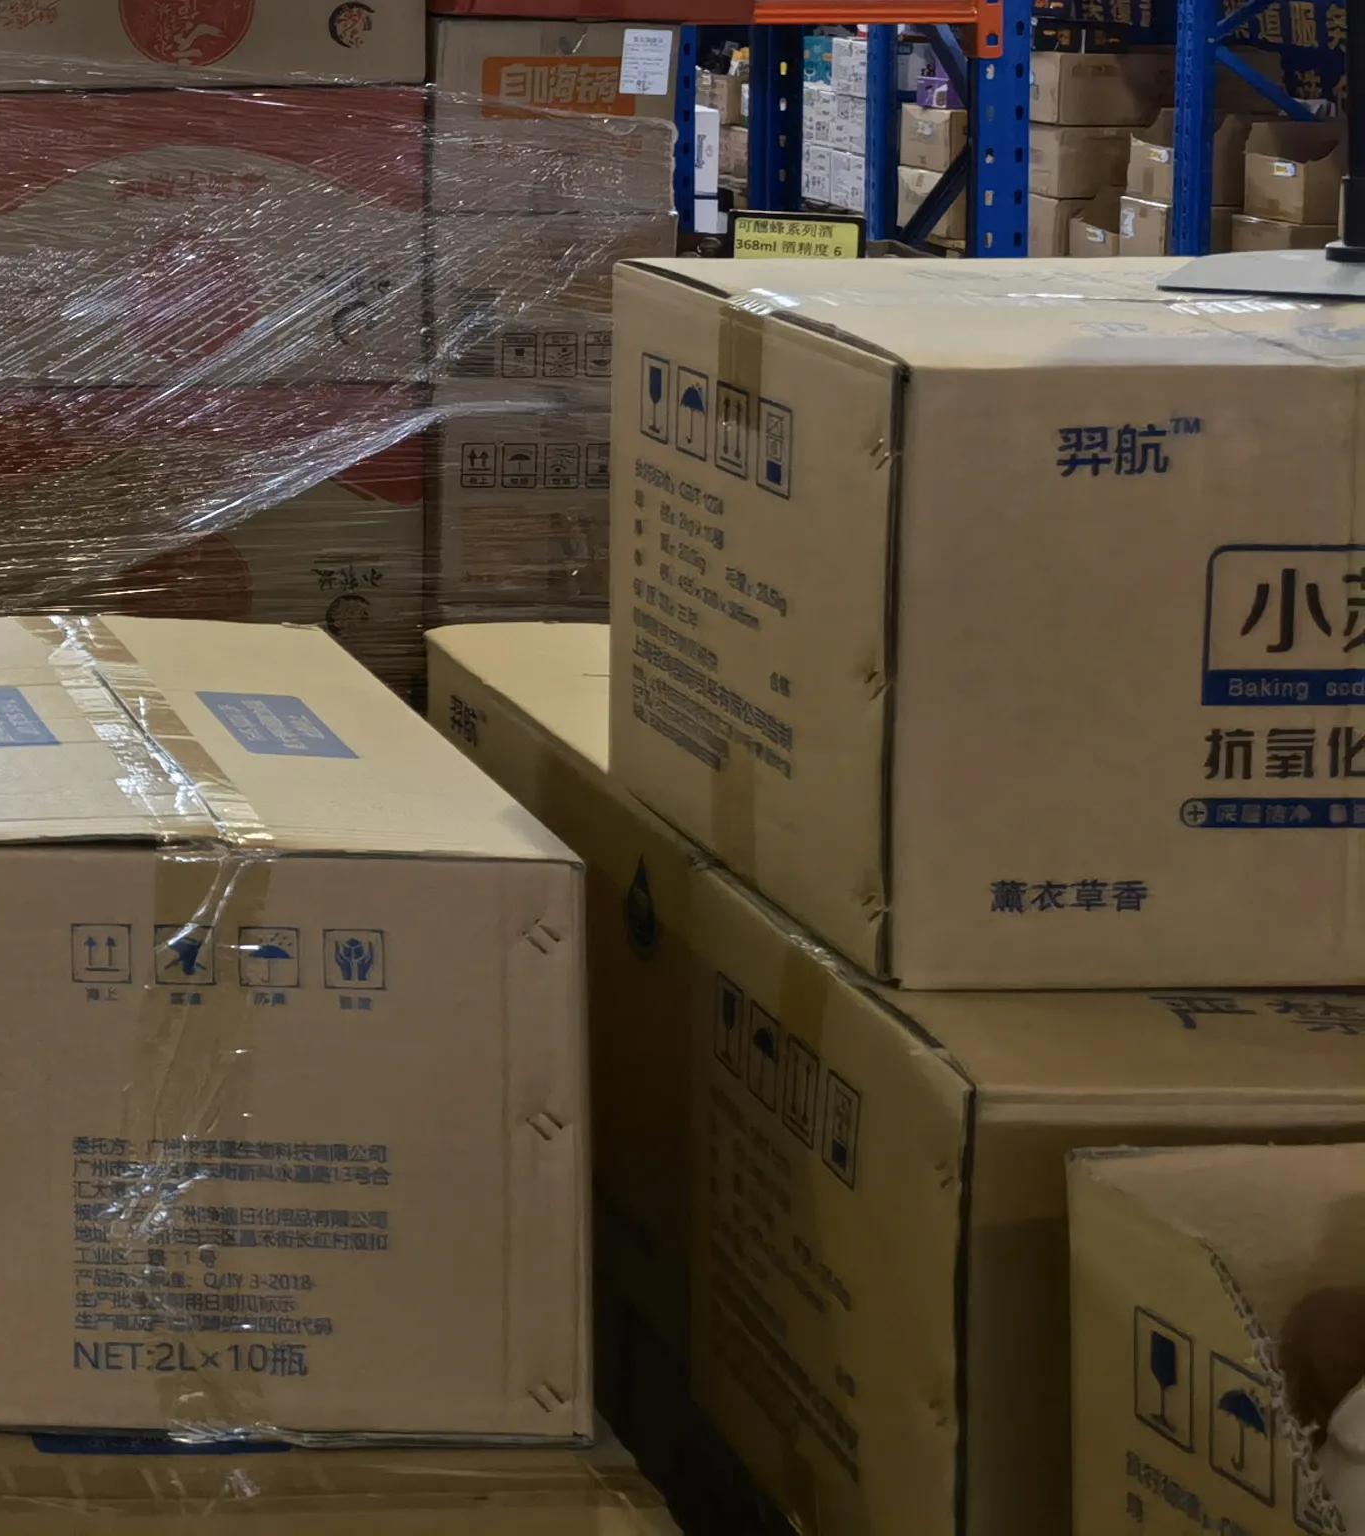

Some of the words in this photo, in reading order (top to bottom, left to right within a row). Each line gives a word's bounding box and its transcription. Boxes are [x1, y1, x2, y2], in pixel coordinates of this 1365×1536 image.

[500, 64, 619, 105] 自嗨锅
[735, 238, 777, 252] 368ml
[1057, 425, 1170, 478] 羿航
[1240, 568, 1365, 654] 小
[1228, 677, 1309, 702] Baking
[1204, 726, 1365, 781] 抗氧化
[73, 1341, 308, 1377] NET:2L×10瓶
